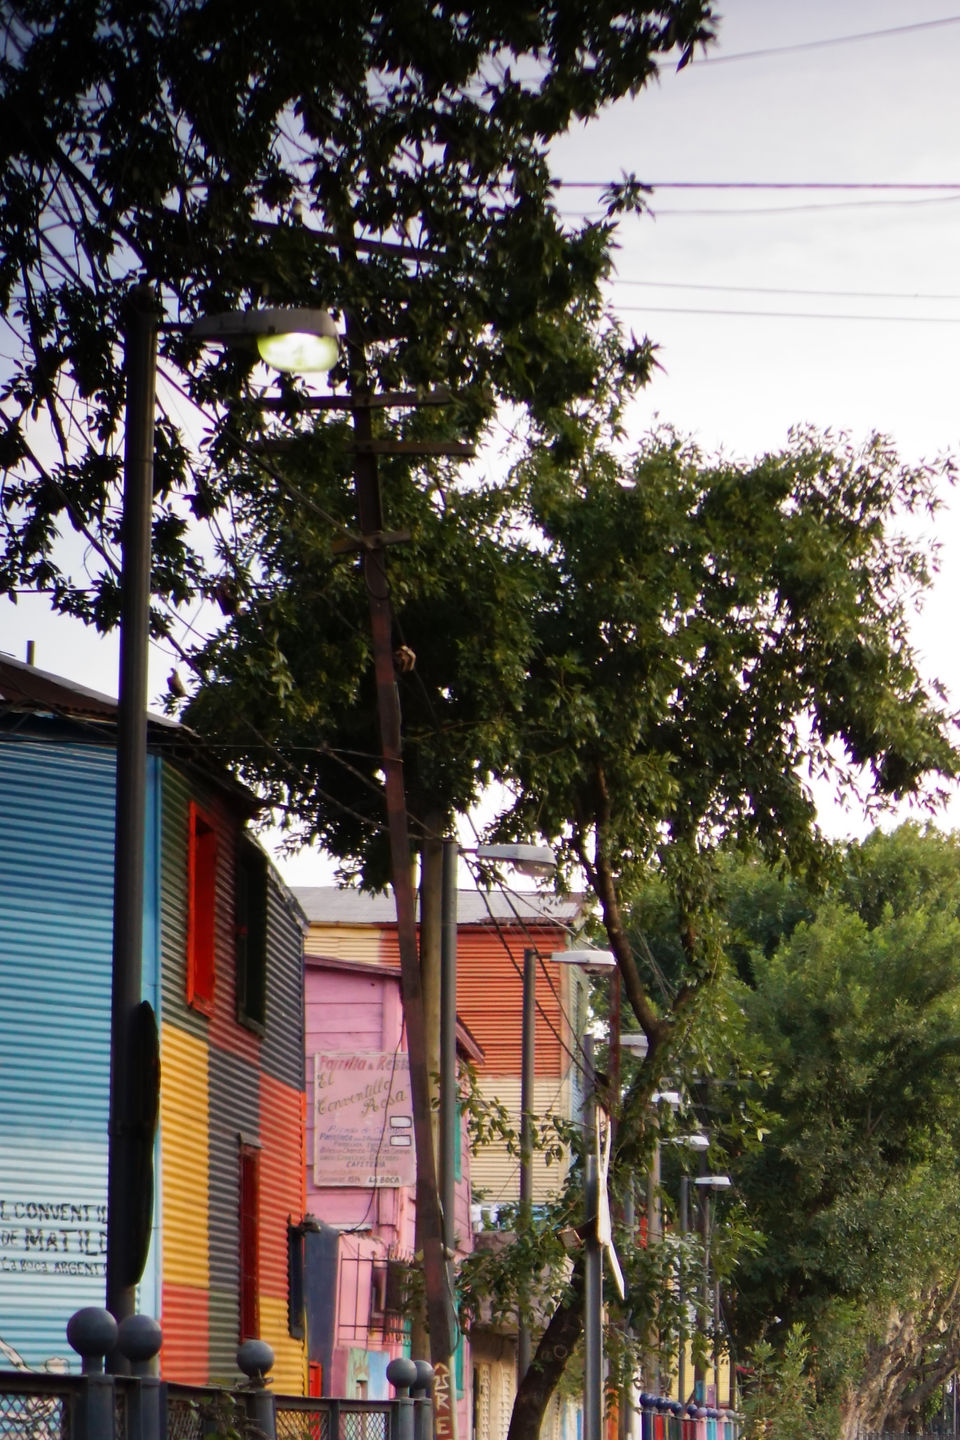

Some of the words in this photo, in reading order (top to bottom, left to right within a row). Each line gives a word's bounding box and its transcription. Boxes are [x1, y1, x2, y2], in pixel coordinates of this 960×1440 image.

[319, 1055, 367, 1071] Parrilla
[317, 1077, 391, 1115] Conventillo
[361, 1090, 406, 1118] Rosa
[379, 1176, 400, 1184] BOCA
[1, 1230, 19, 1246] DE
